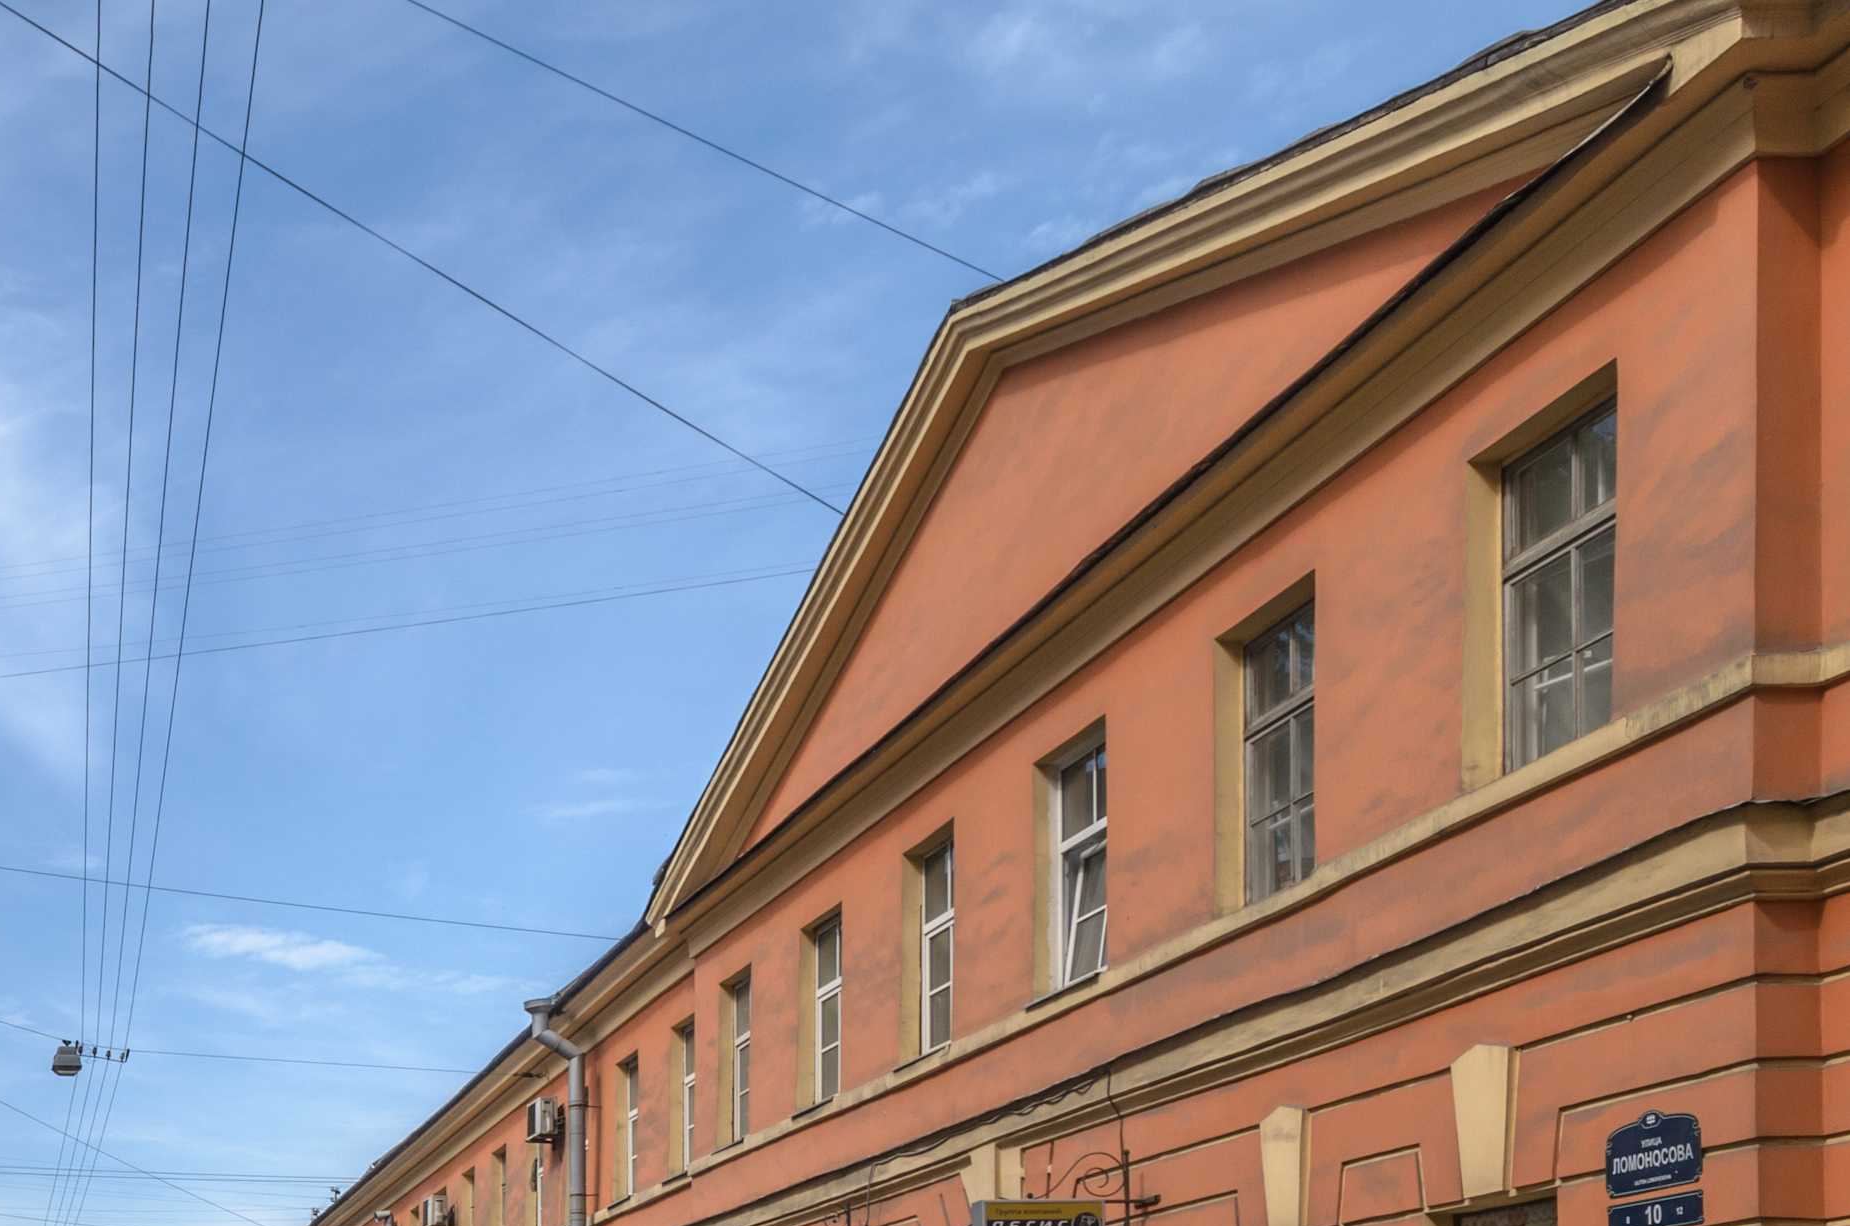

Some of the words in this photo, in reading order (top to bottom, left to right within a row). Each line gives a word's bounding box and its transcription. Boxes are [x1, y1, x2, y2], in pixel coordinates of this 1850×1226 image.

[1641, 1136, 1662, 1148] УЛИЦА
[1612, 1143, 1694, 1175] ЛОМОНОСОВА
[995, 1208, 1022, 1216] Группа
[1645, 1204, 1662, 1225] 10
[1676, 1206, 1684, 1215] 12
